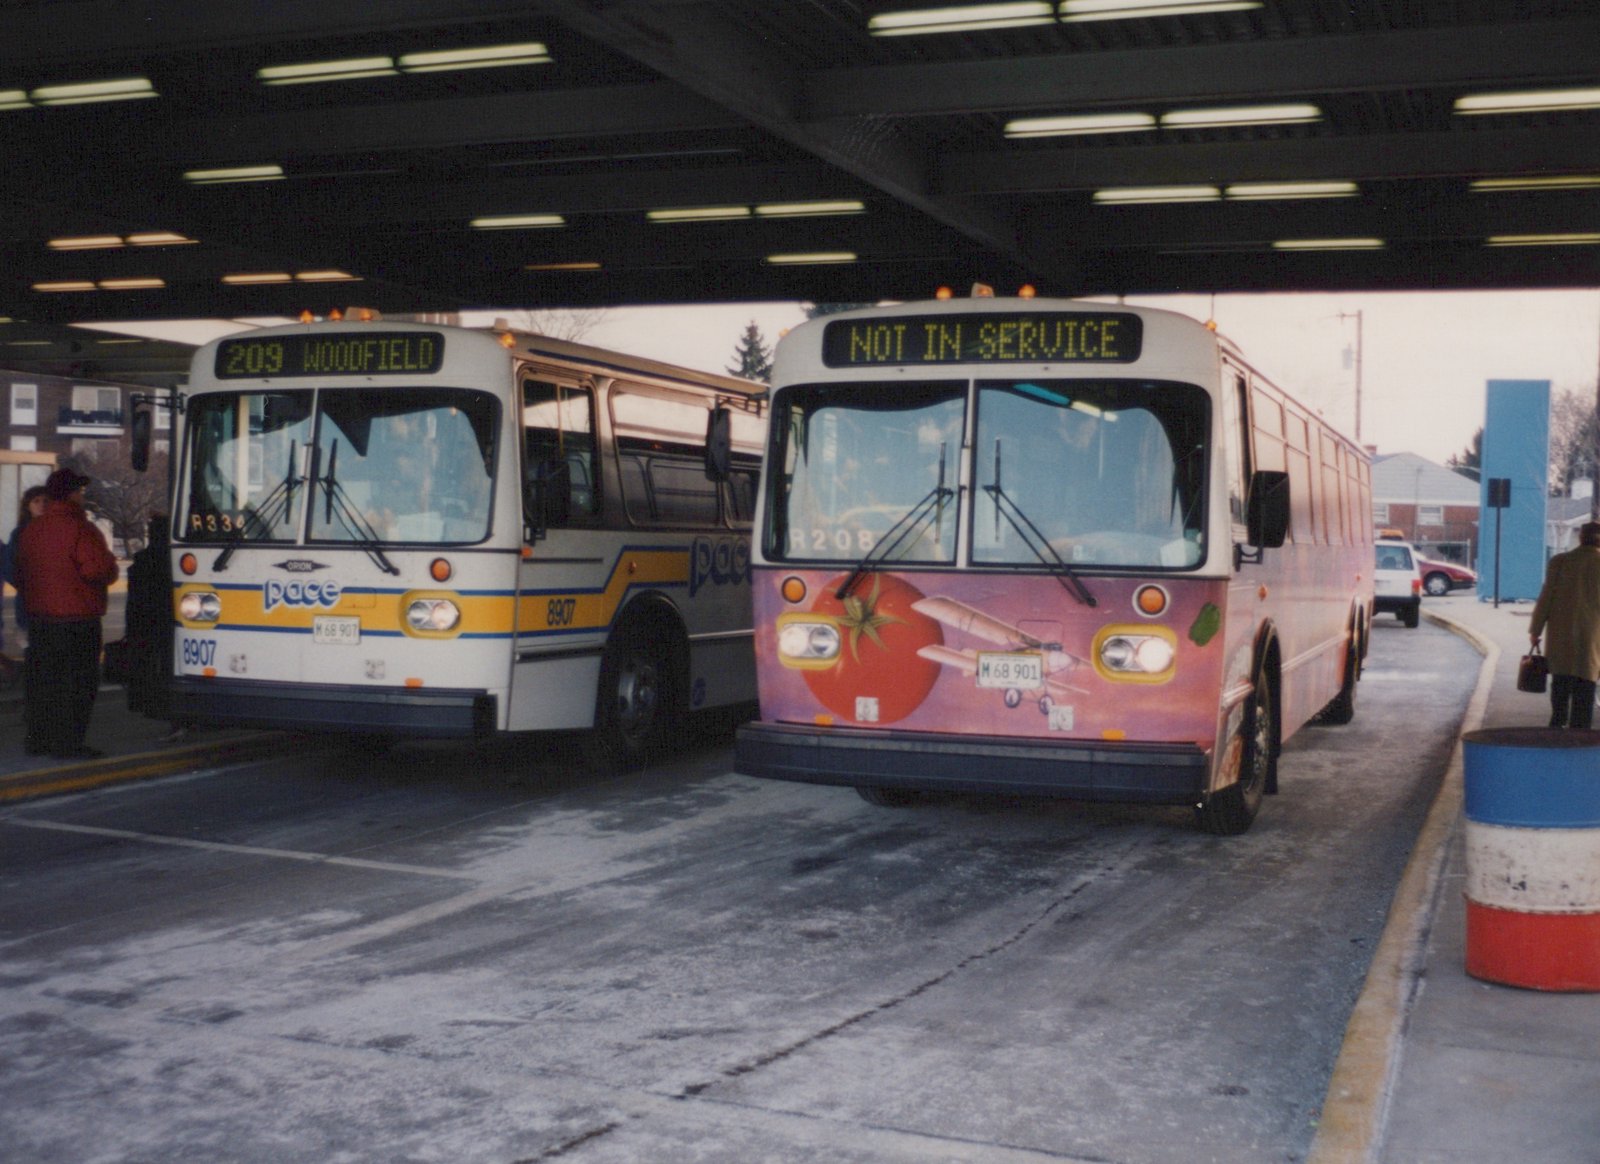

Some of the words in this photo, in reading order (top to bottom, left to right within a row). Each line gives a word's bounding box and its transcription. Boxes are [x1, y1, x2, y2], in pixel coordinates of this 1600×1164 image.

[851, 325, 906, 362] NOT
[924, 323, 961, 360] IN
[979, 320, 1119, 359] SERVICE
[226, 344, 284, 375] 209
[303, 338, 434, 373] WOODFIELD
[789, 528, 875, 551] R208
[263, 579, 341, 612] pace
[546, 599, 576, 626] 8907
[183, 639, 216, 666] 8907
[994, 663, 1009, 679] 68
[1013, 664, 1038, 680] 901
